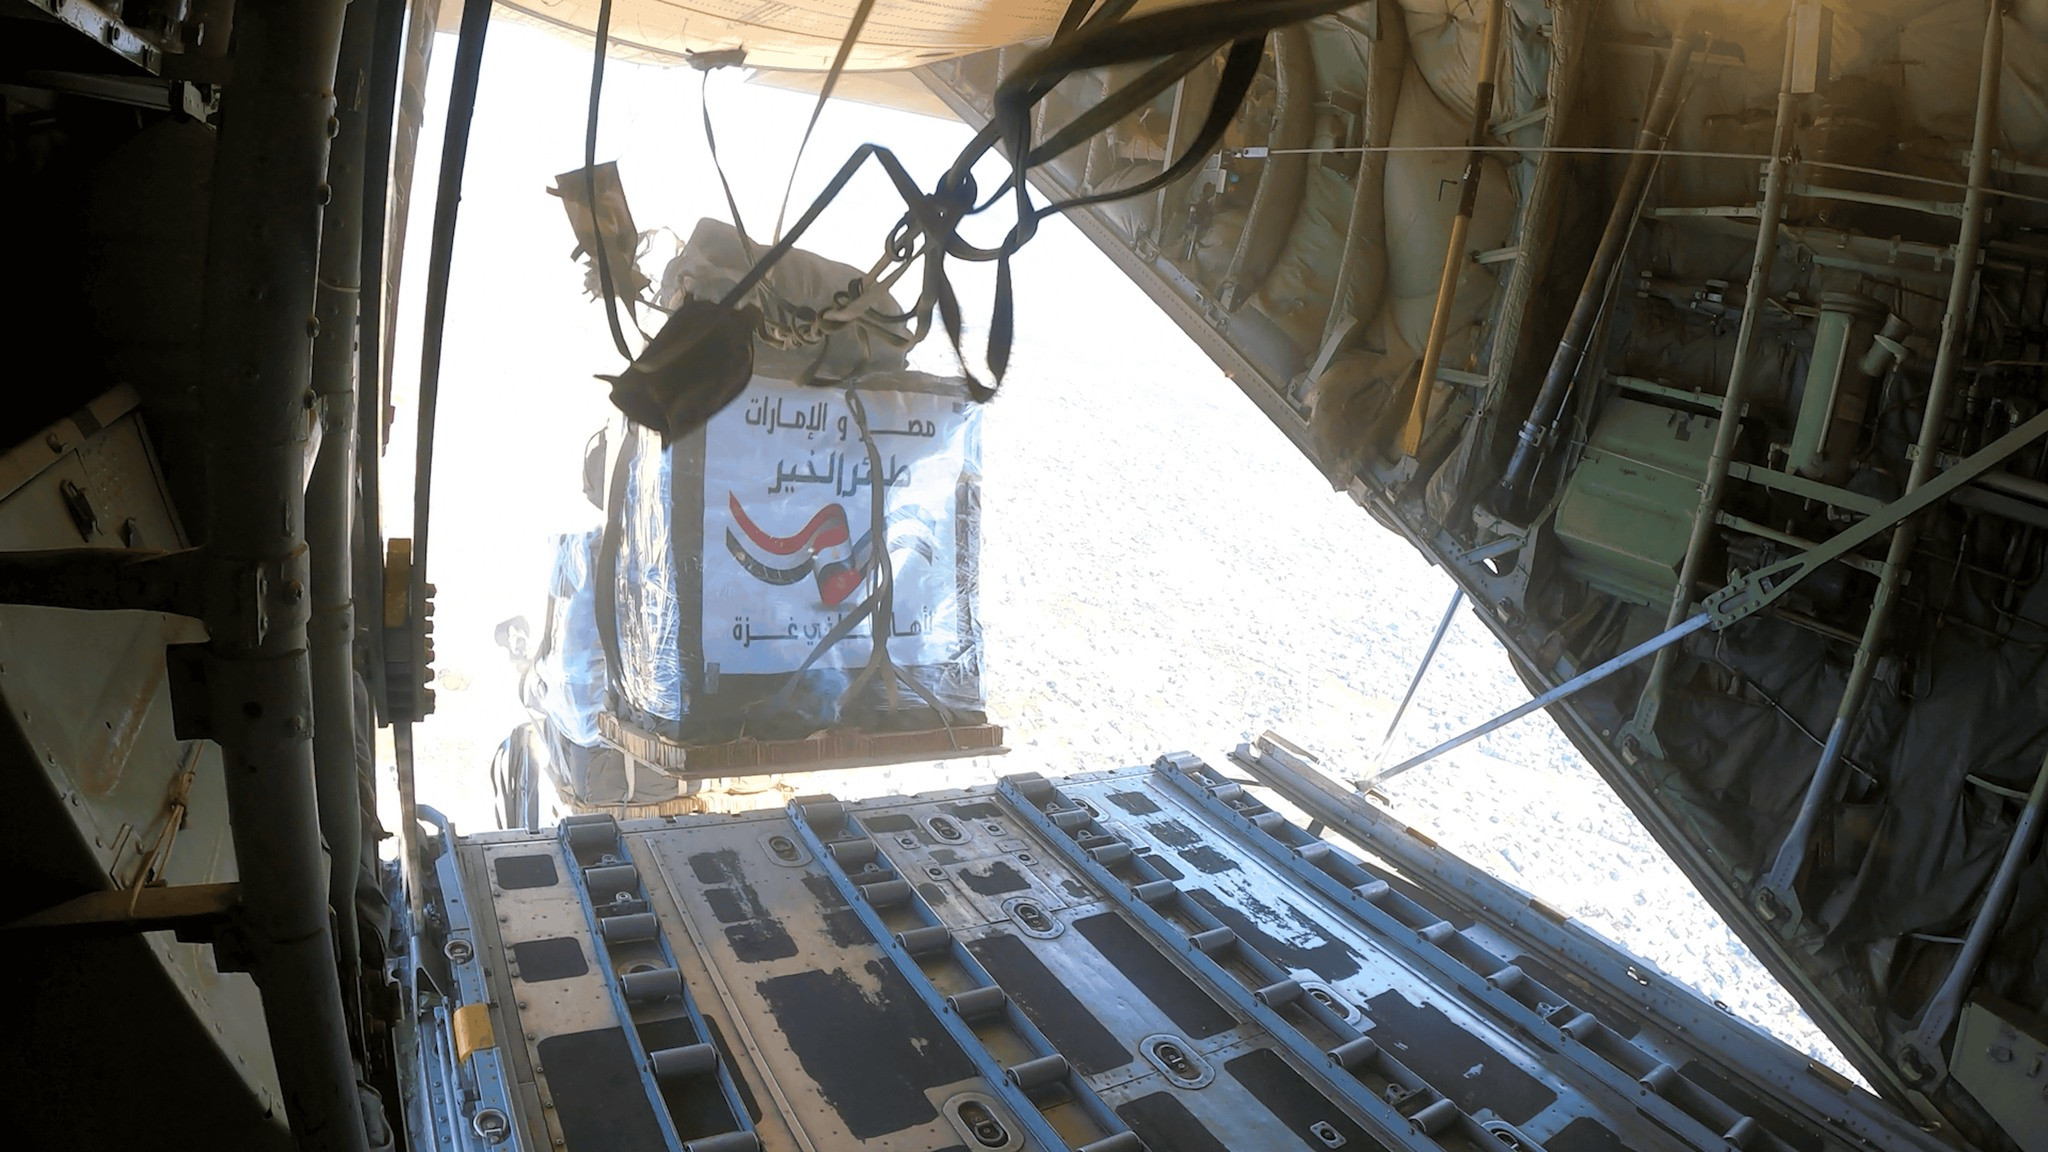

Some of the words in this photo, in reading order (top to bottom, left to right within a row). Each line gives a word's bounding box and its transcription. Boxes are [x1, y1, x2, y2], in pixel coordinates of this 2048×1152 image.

[745, 395, 828, 440] الإمارات
[837, 415, 848, 441] و
[859, 419, 936, 442] مص
[767, 449, 845, 496] الخير
[841, 453, 912, 498] طئر
[733, 616, 799, 648] غزة
